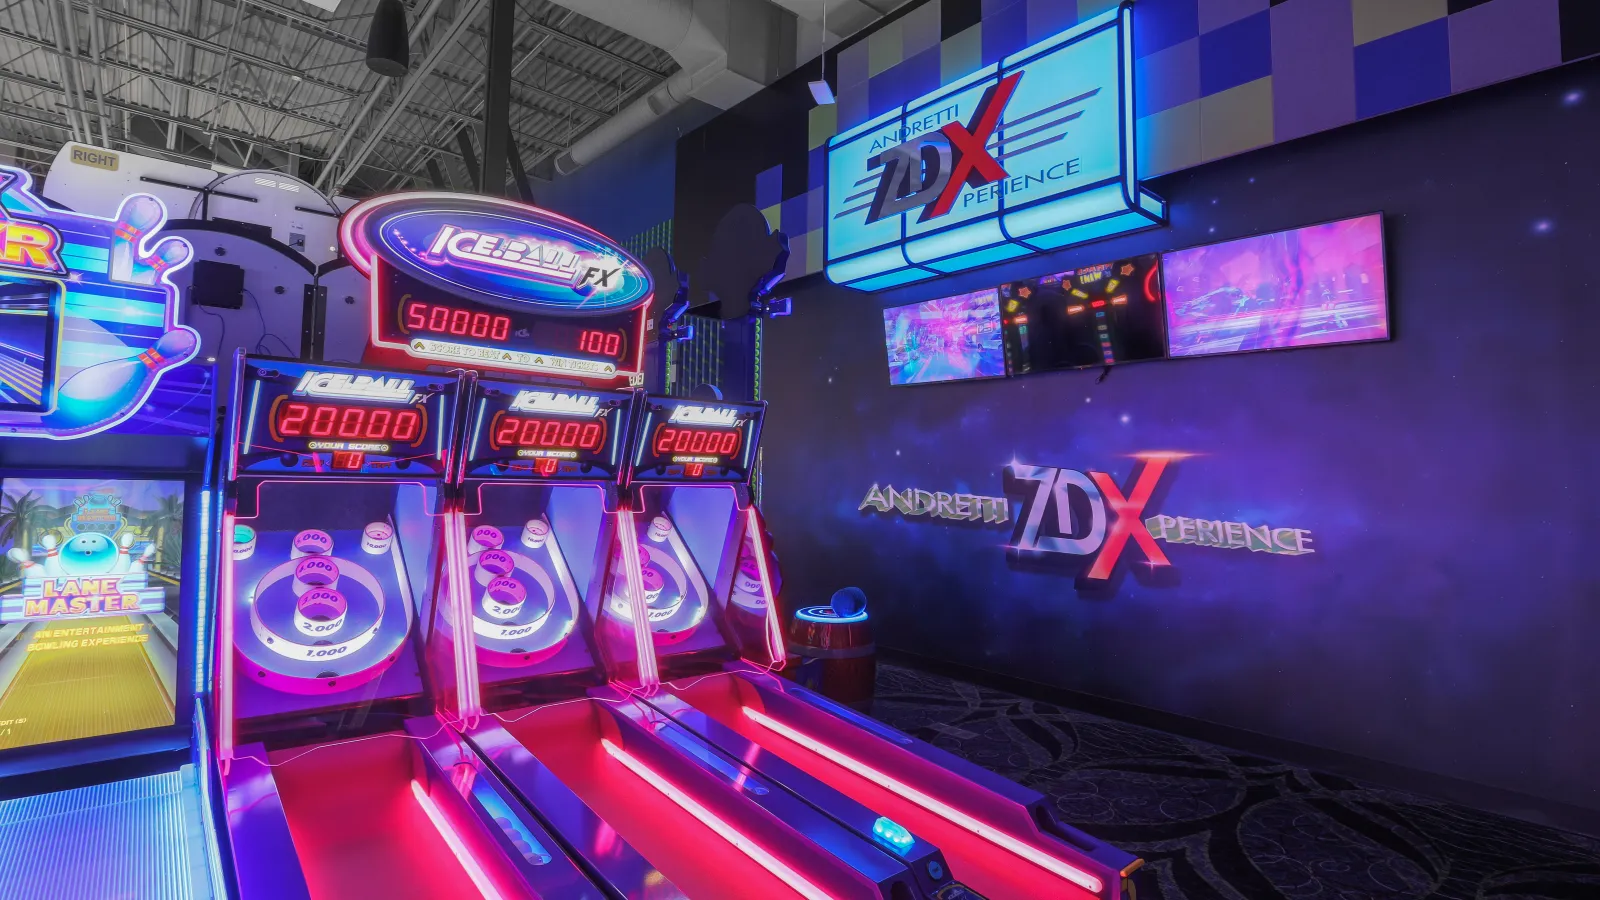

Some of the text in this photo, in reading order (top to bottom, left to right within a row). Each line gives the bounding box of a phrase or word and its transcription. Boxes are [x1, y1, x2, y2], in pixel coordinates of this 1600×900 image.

[869, 104, 960, 154] ANDRETTI
[73, 149, 117, 167] RIGHT
[577, 266, 621, 289] FX
[408, 303, 621, 356] 50000 100
[429, 342, 461, 355] SCORE
[461, 345, 476, 356] TO
[516, 353, 530, 364] TO
[409, 393, 435, 405] FX
[280, 404, 418, 440] 20000
[497, 418, 600, 448] 20000
[317, 441, 382, 451] YOUR SCORE
[658, 429, 738, 454] 20000
[347, 451, 362, 468] 0
[545, 458, 557, 473] 0
[857, 483, 1010, 524] ANDRETTI
[43, 578, 119, 598] LANE
[24, 594, 142, 617] MASTER
[53, 624, 146, 638] ENTERTAINMENT
[26, 634, 149, 652] BOWLING EXPERIENCE
